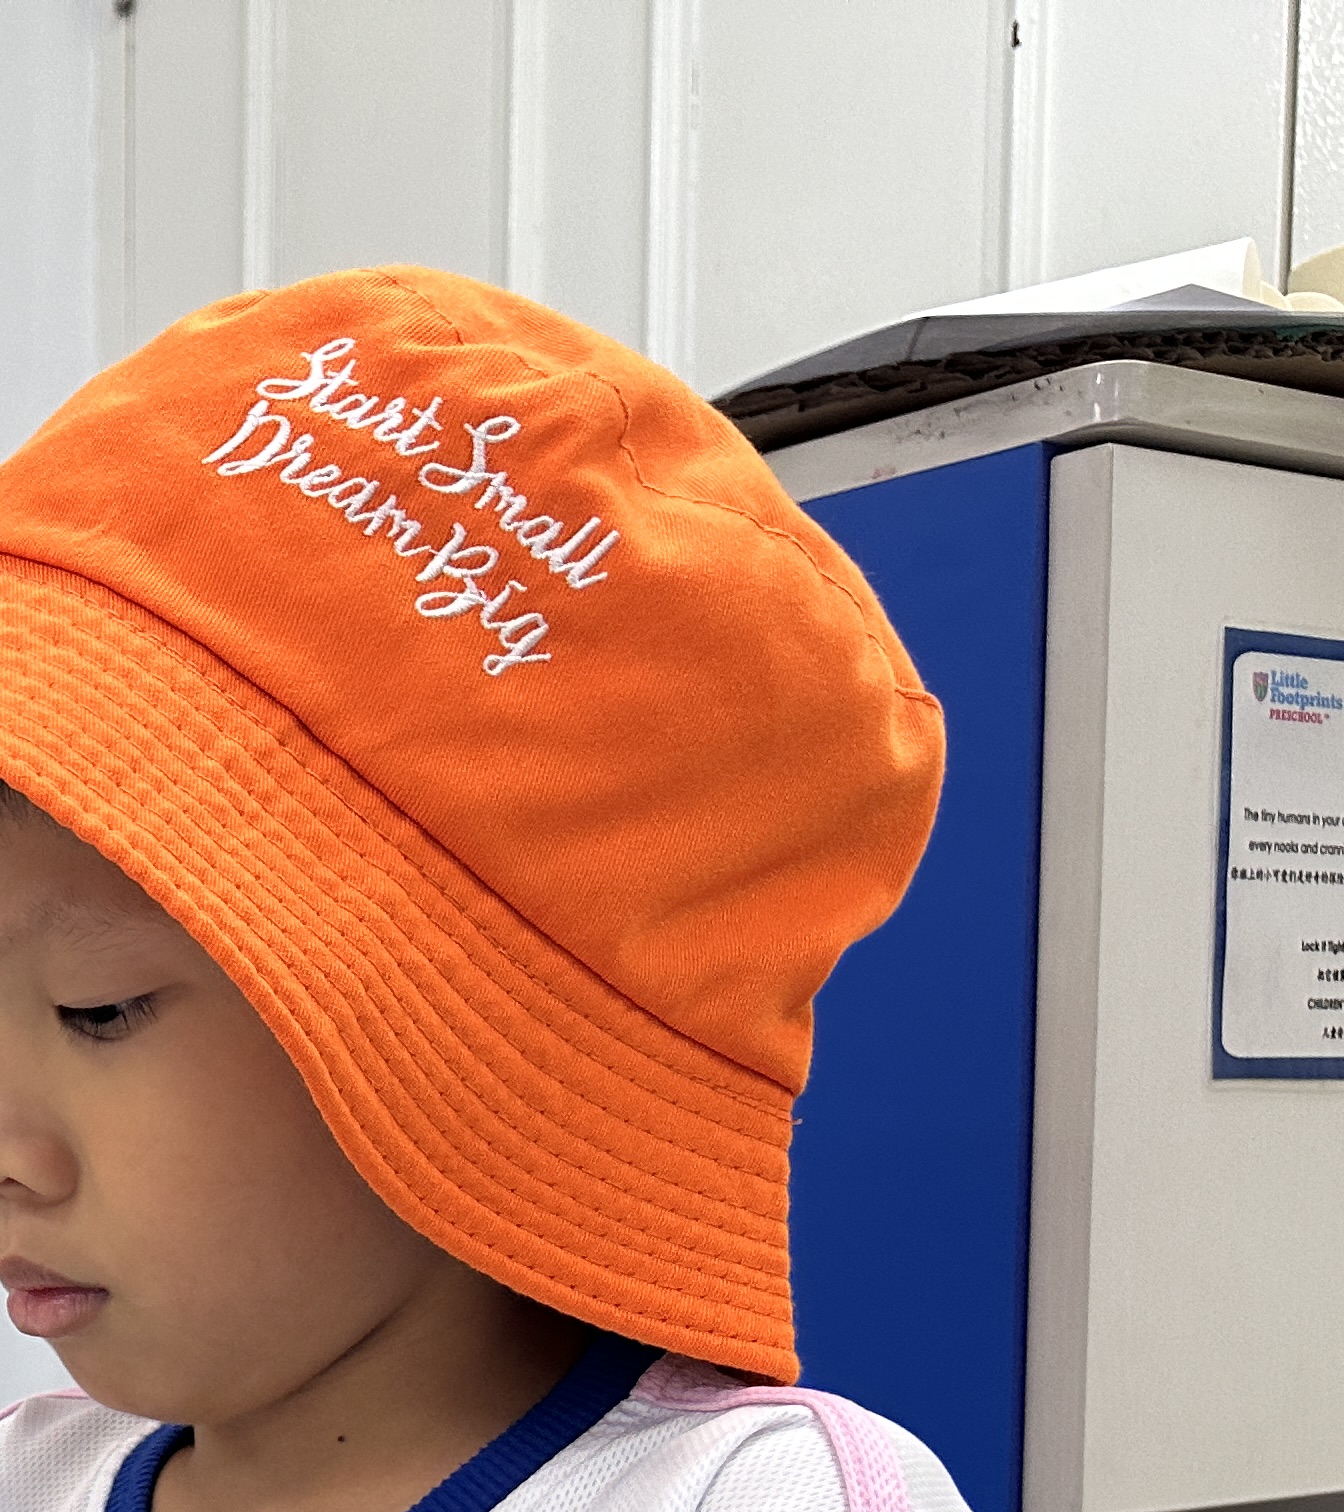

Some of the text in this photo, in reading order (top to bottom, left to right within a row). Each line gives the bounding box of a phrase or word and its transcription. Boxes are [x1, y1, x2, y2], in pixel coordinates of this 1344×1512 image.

[255, 338, 621, 590] Start Small
[201, 400, 552, 676] Dream Big
[1270, 669, 1309, 690] Little
[1269, 686, 1344, 711] Footprints
[1244, 807, 1341, 828] The tiny humans in your
[1248, 840, 1272, 855] every
[1273, 841, 1299, 854] nooks
[1300, 841, 1318, 854] and
[1301, 940, 1320, 952] Lock
